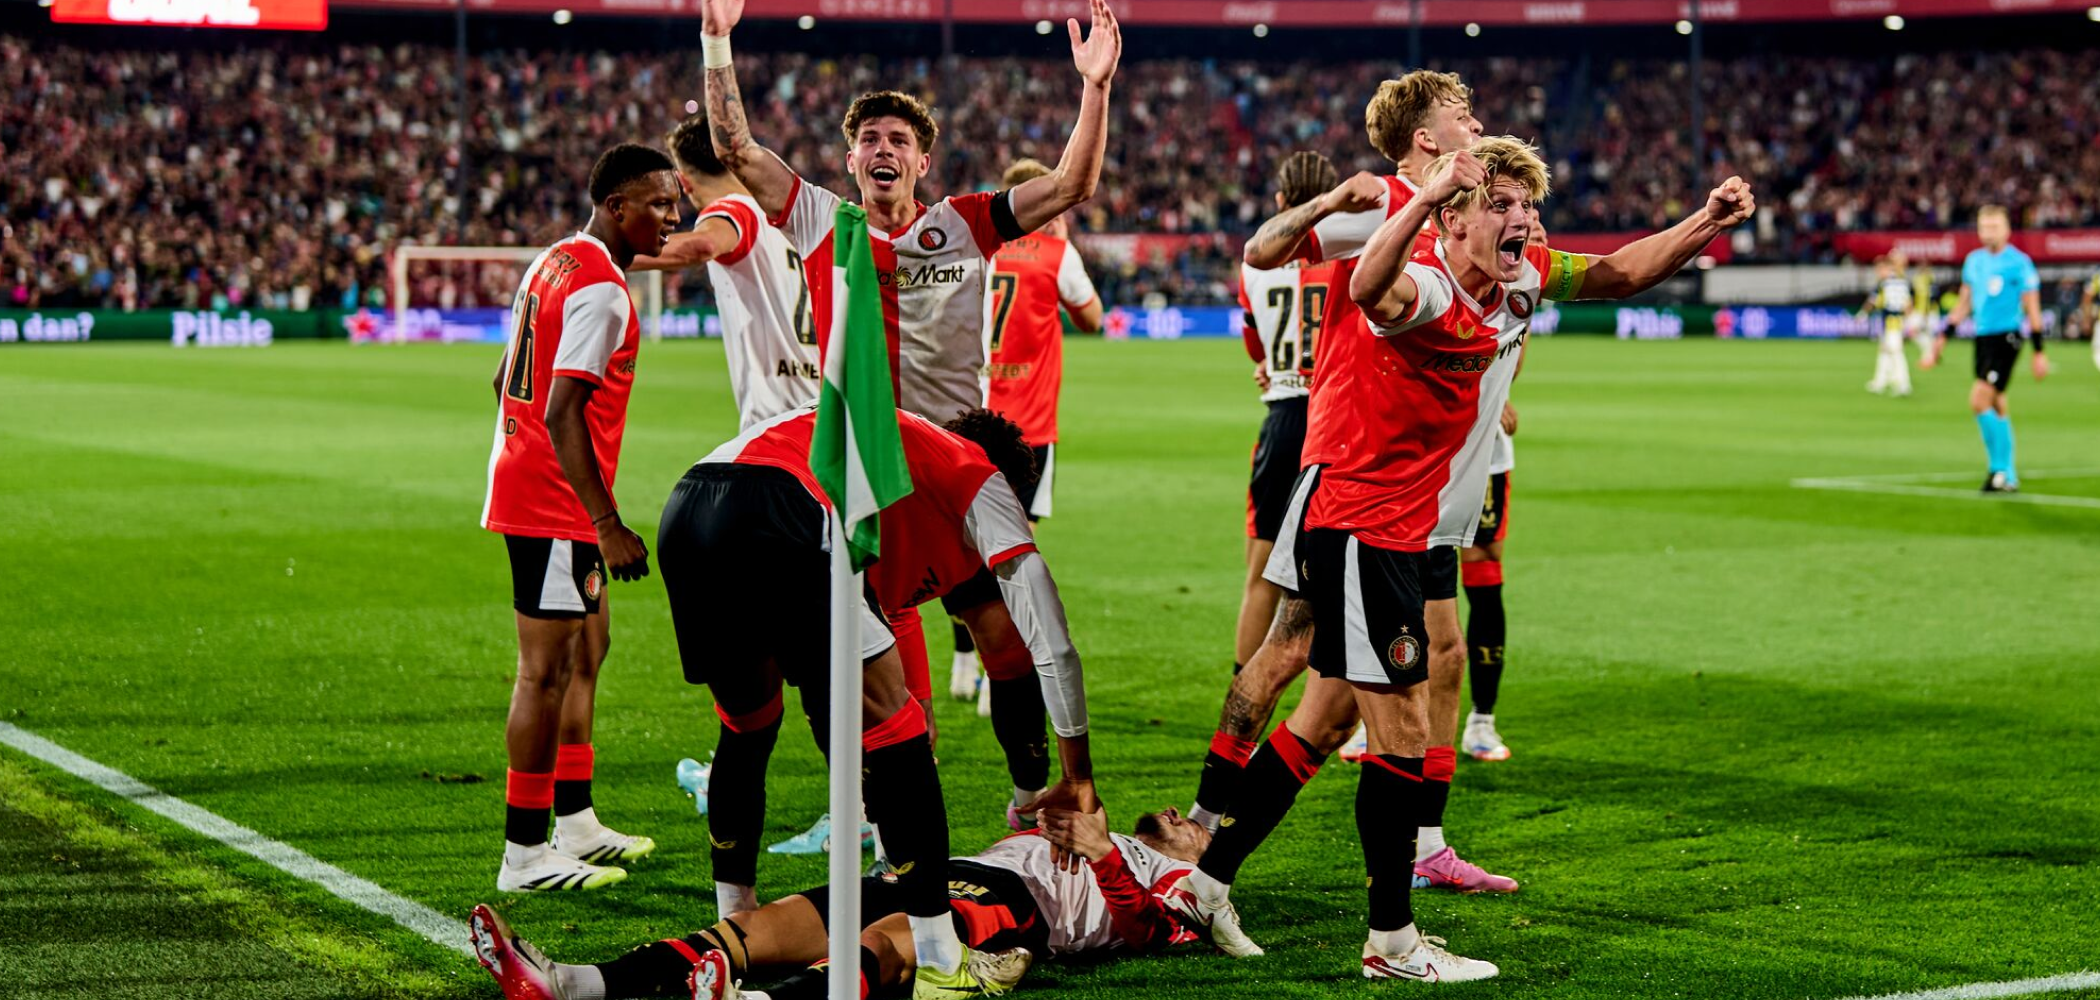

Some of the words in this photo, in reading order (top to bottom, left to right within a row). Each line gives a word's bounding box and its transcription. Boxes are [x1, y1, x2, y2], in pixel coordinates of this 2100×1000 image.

[910, 263, 964, 286] Markt
[22, 311, 94, 342] dan?
[990, 271, 1019, 352] 7
[1267, 284, 1328, 371] 28
